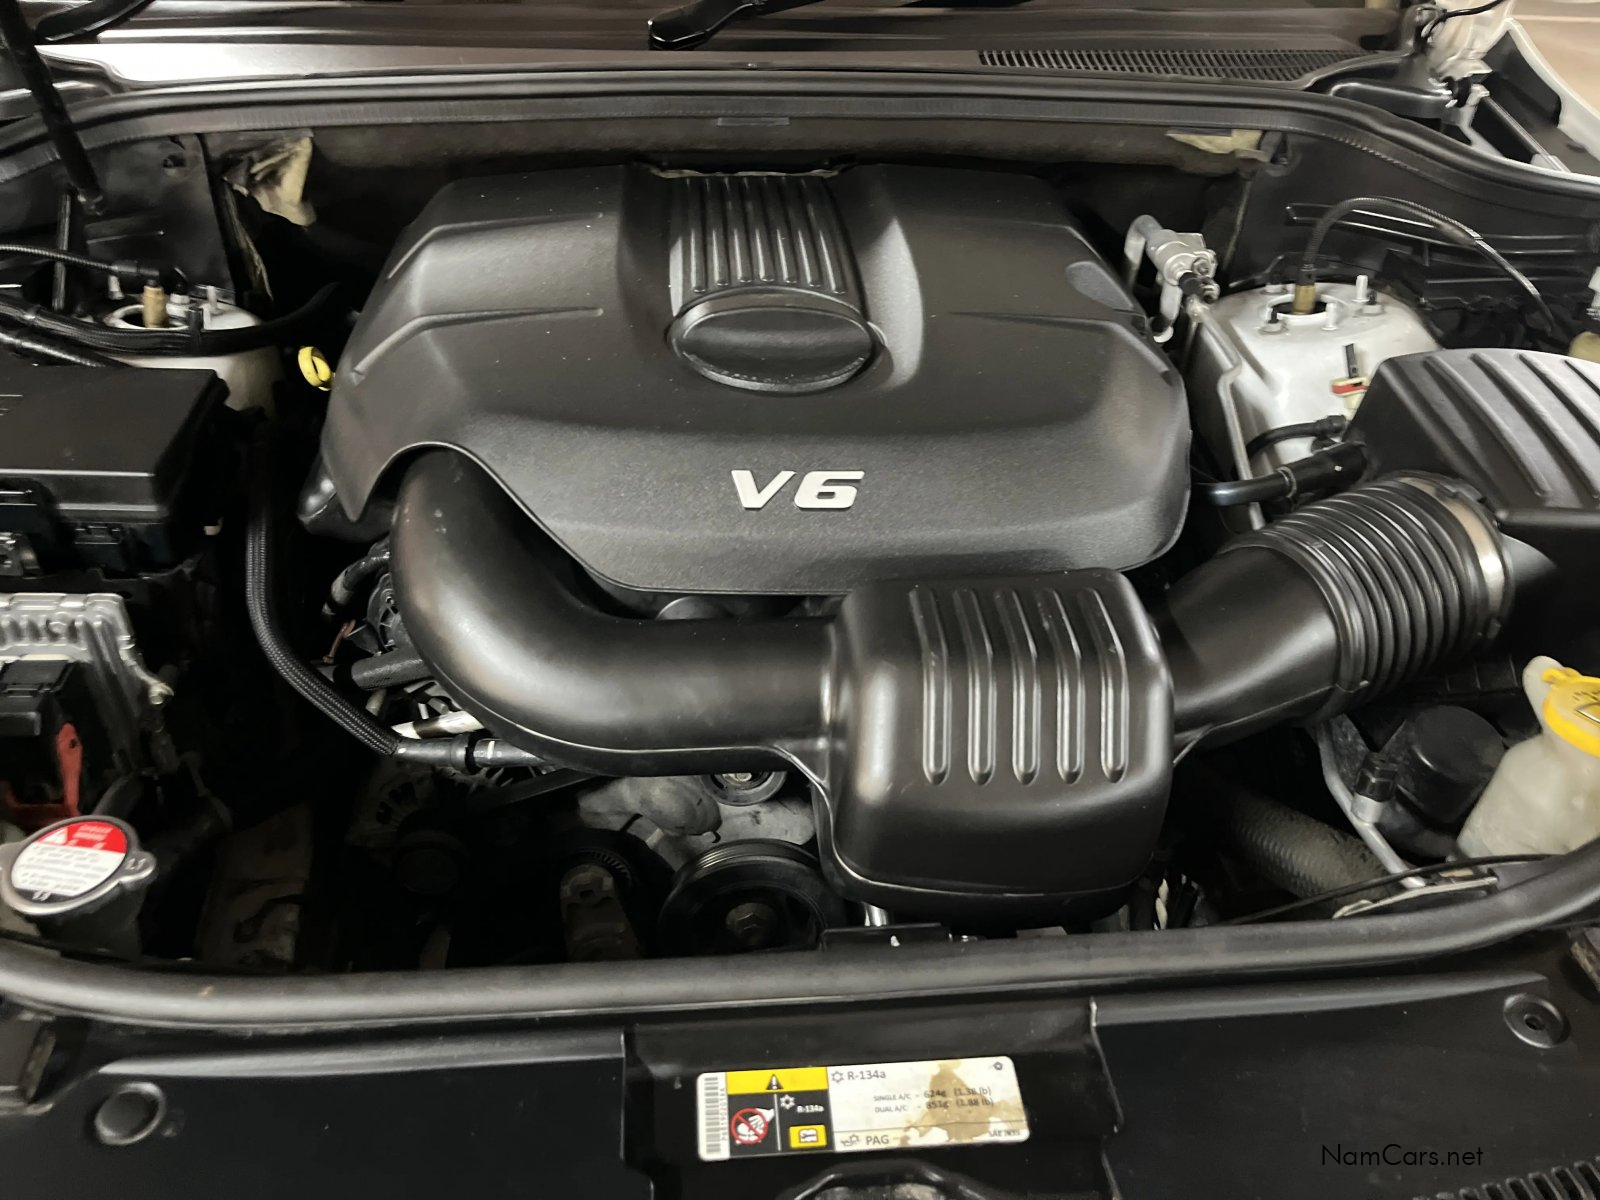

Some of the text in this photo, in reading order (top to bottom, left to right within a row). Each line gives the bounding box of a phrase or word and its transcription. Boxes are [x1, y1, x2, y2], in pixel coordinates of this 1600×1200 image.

[731, 470, 865, 510] V6
[847, 1070, 886, 1080] R-134a
[873, 1094, 898, 1102] SINGLE
[898, 1092, 912, 1101] A/C
[875, 1105, 894, 1113] DUAL
[894, 1104, 908, 1112] A/C
[865, 1134, 889, 1145] PAG
